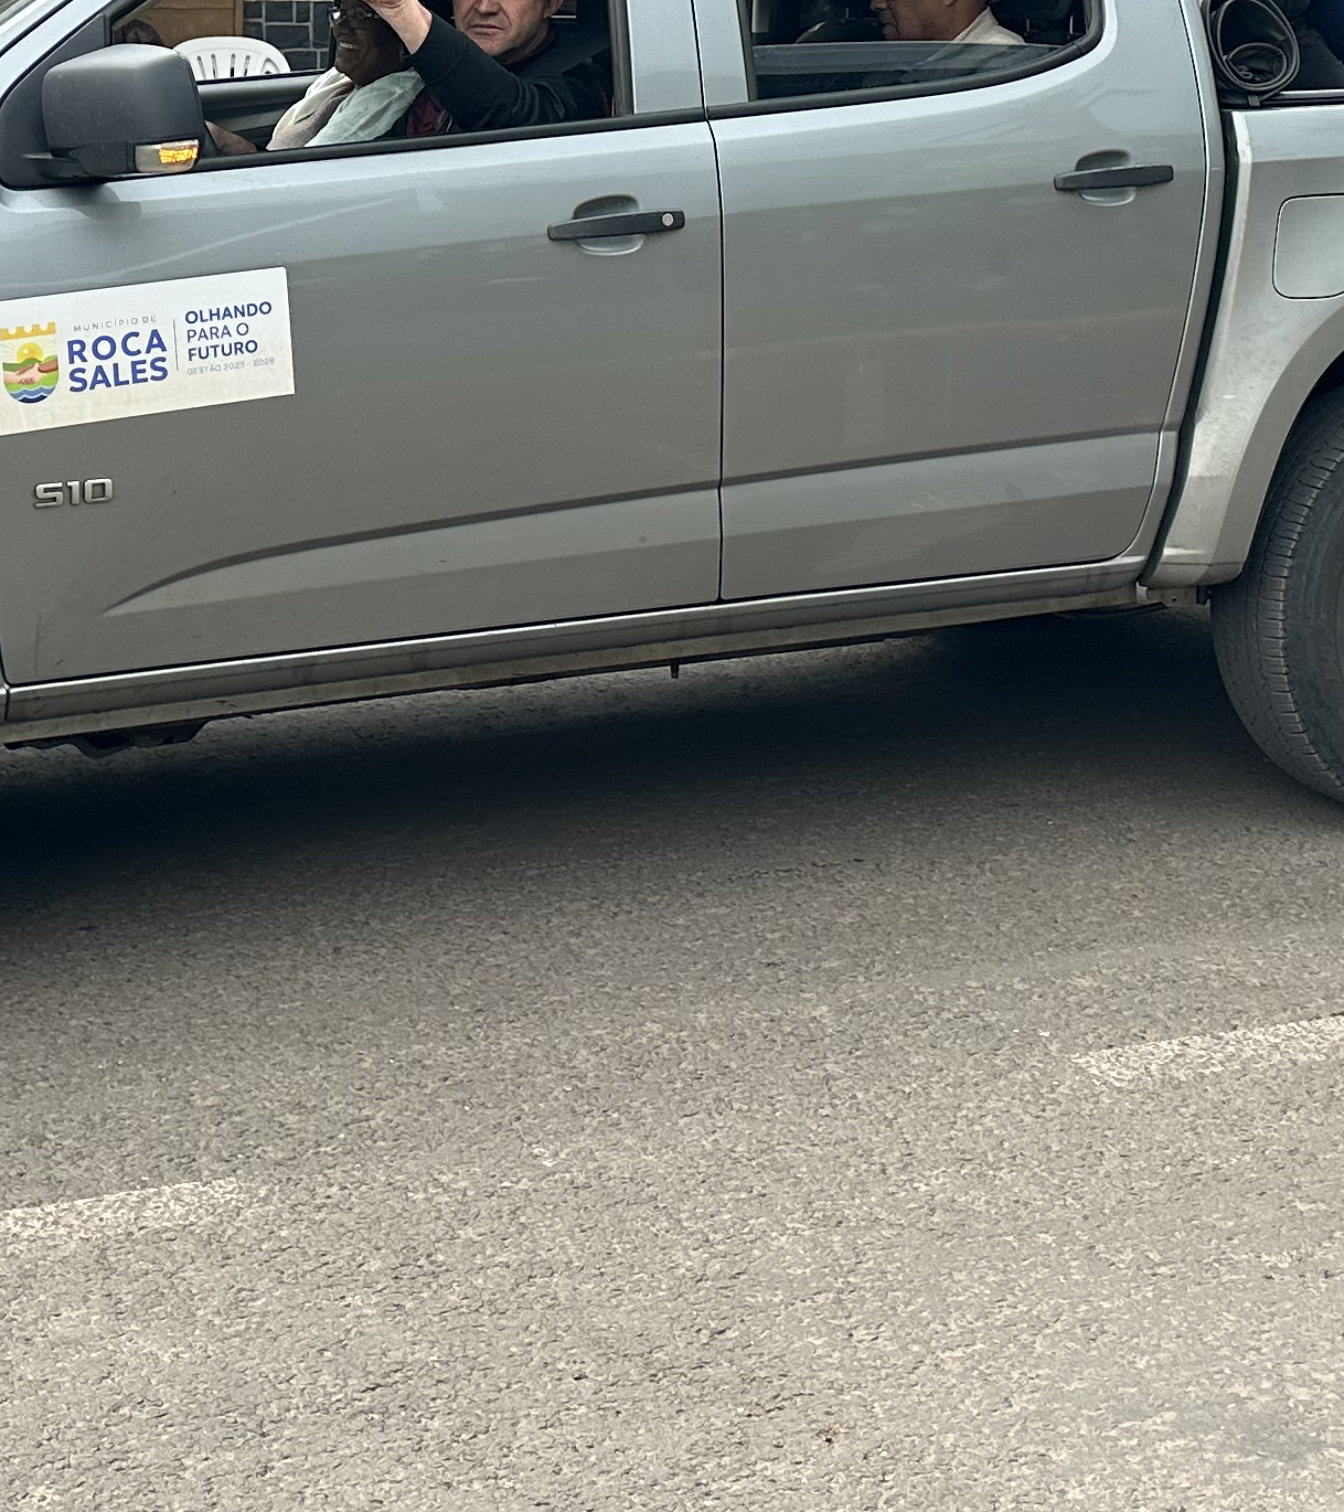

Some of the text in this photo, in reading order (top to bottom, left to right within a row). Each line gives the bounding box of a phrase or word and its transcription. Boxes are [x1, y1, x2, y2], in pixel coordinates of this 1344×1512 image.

[73, 315, 156, 333] MUNICÍPIO DE
[185, 301, 272, 324] OLHANDO
[187, 322, 249, 343] PARA O
[67, 329, 167, 364] ROCA
[188, 340, 258, 361] FUTURO
[69, 356, 168, 393] SALES
[34, 477, 114, 509] S10
